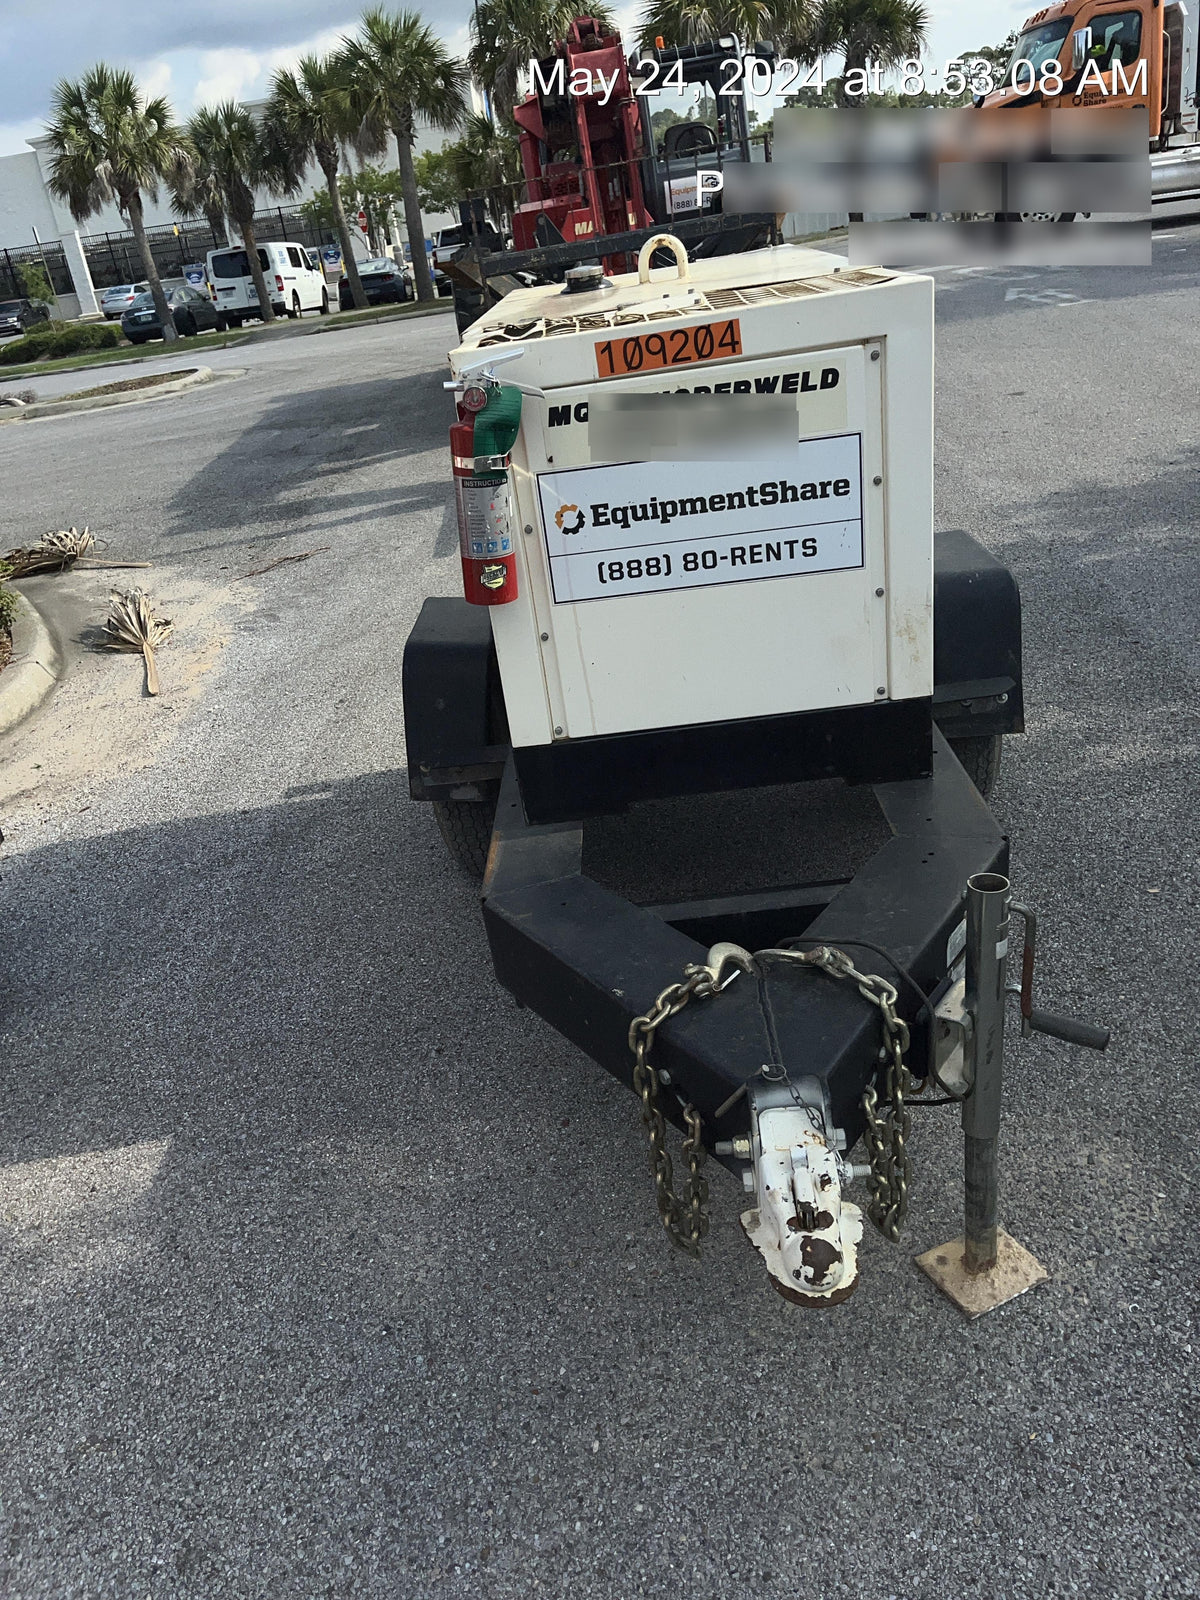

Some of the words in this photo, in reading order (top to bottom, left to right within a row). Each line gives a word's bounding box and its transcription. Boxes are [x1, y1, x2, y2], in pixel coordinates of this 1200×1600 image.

[1083, 98, 1107, 107] Share
[600, 320, 740, 373] 109204
[590, 478, 851, 529] EquipmentShare
[597, 553, 672, 584] (888)
[683, 537, 818, 572] 80-RENTS
